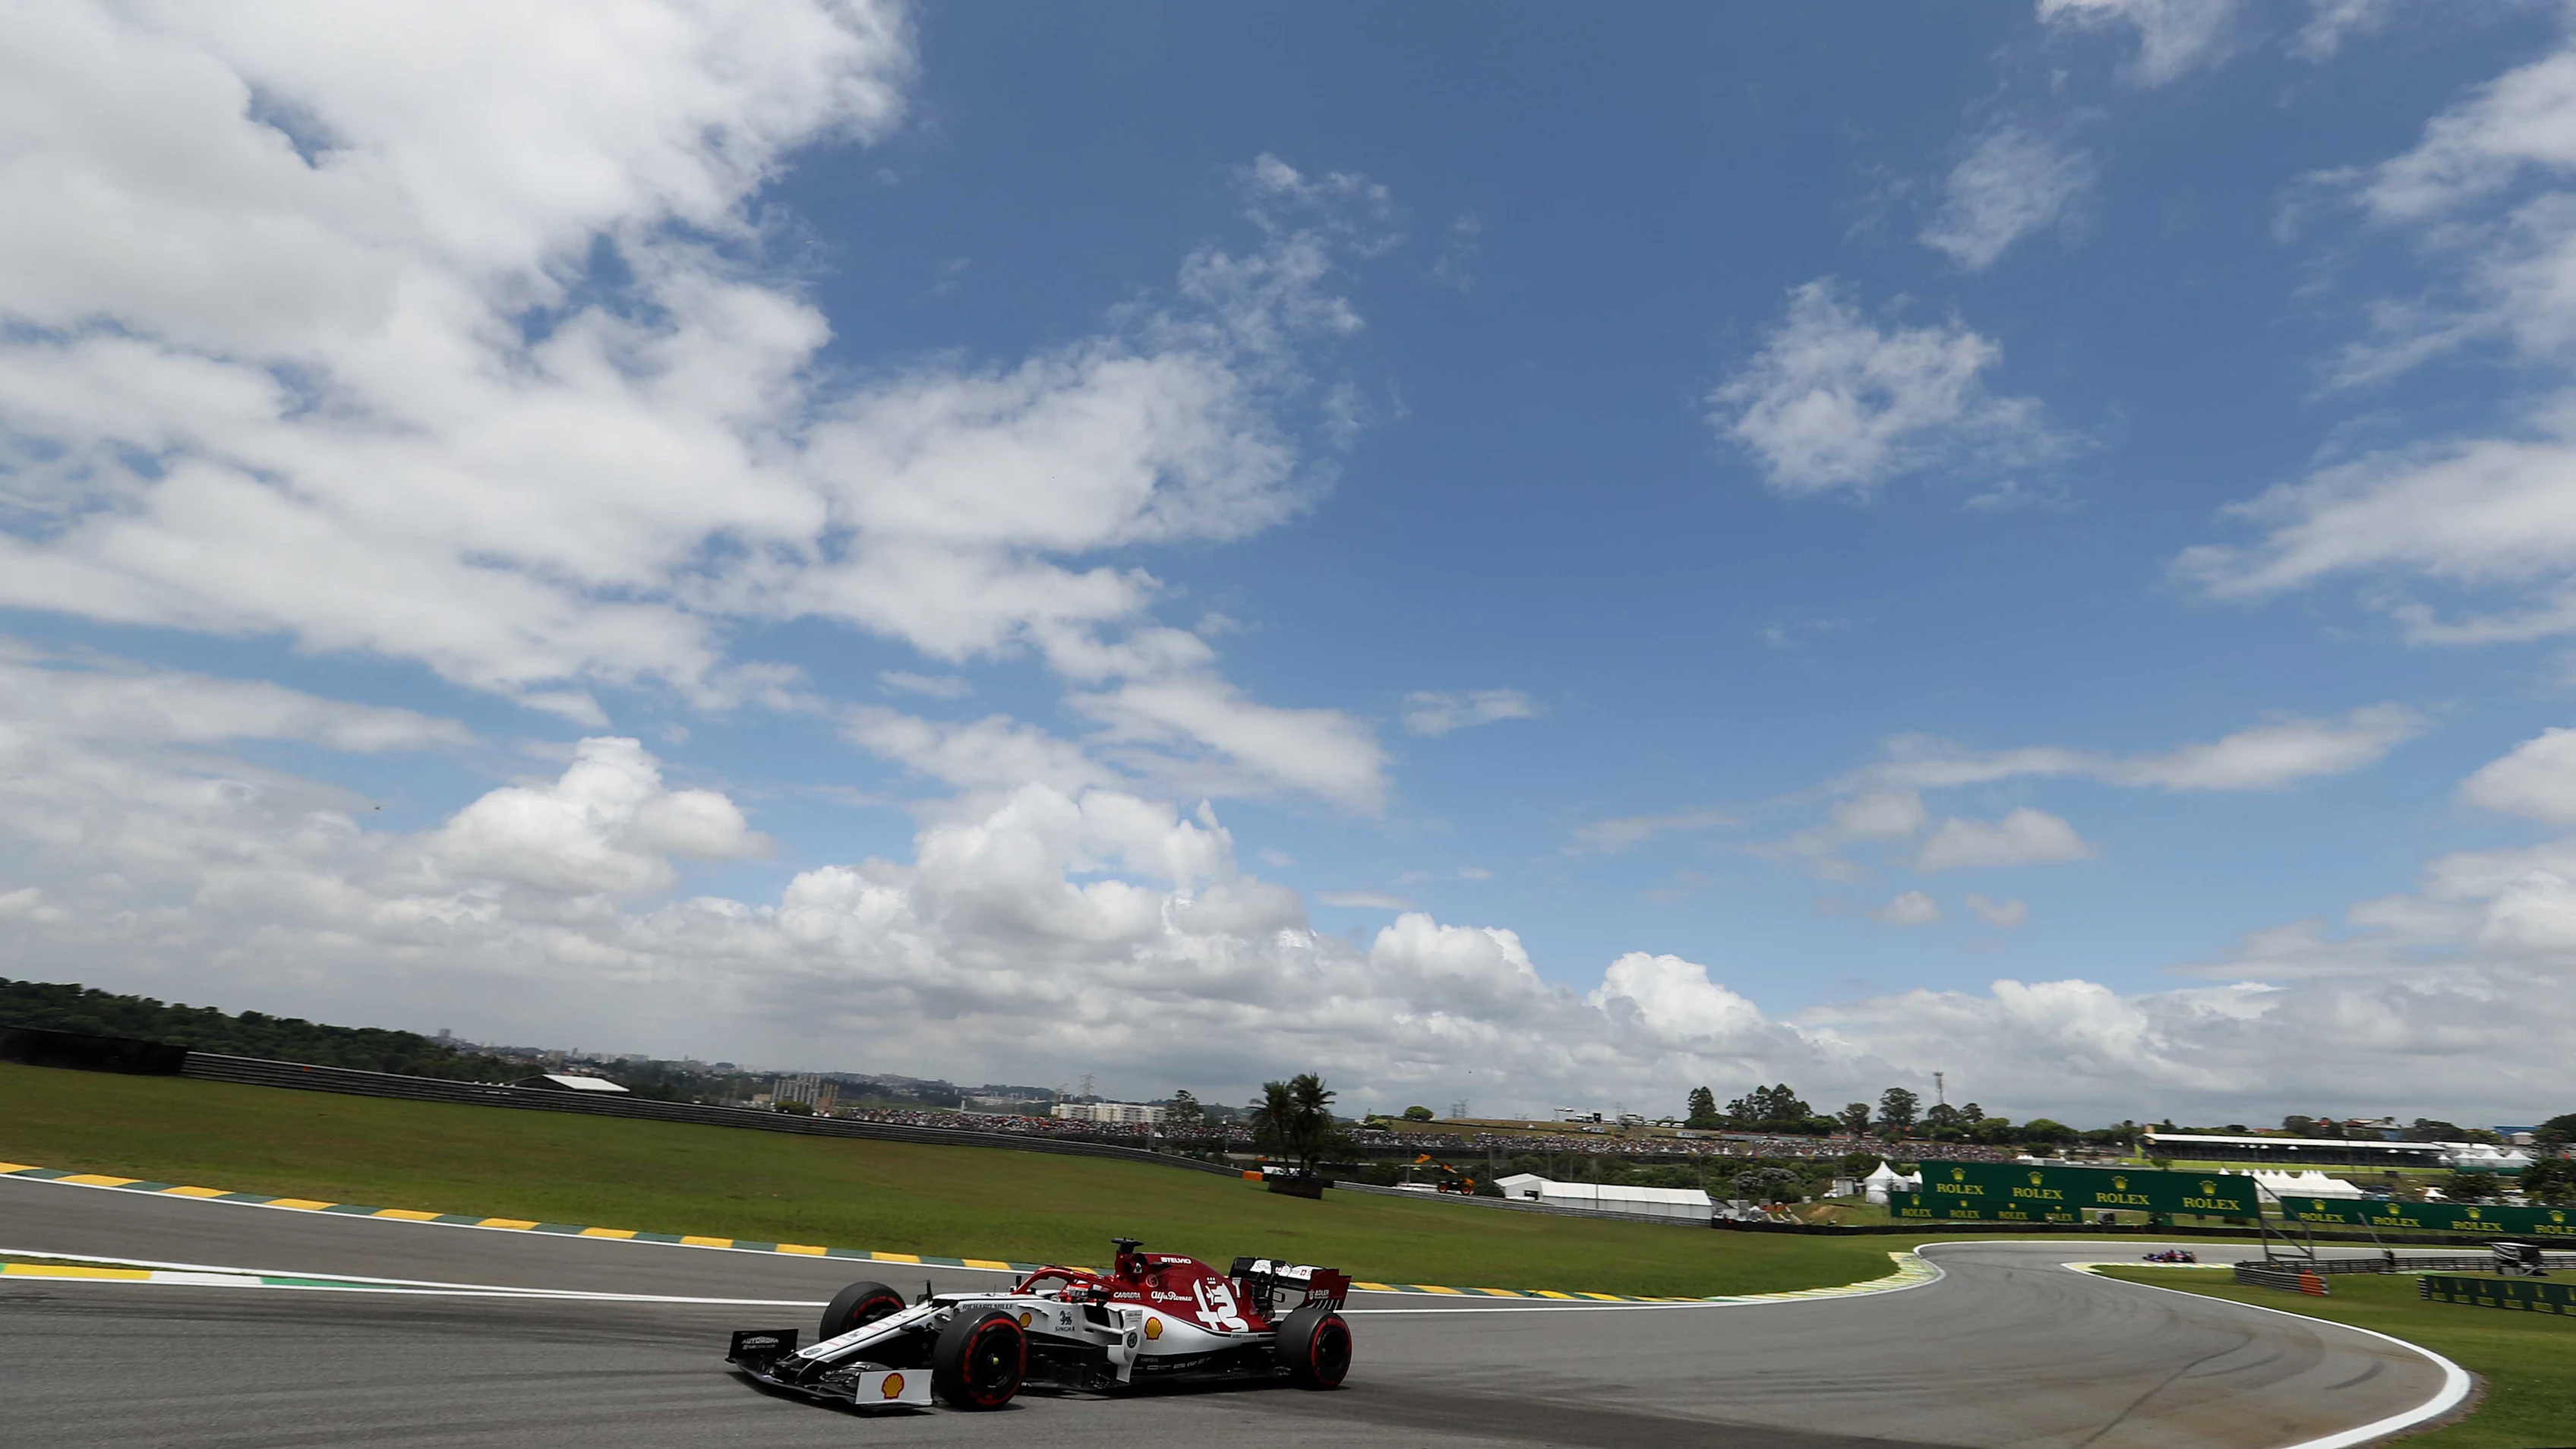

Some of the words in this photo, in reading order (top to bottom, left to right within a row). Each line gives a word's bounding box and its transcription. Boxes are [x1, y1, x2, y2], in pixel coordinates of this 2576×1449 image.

[1937, 1183, 1984, 1195] ROLEX
[2012, 1187, 2063, 1200] ROLEX
[2095, 1192, 2151, 1205] ROLEX
[2183, 1197, 2241, 1211] ROLEX
[1901, 1208, 1932, 1217] ROLEX
[1949, 1210, 1980, 1219] ROLEX
[1998, 1211, 2028, 1220] ROLEX
[2298, 1213, 2345, 1223] ROLEX
[2372, 1217, 2422, 1227] ROLEX
[2451, 1220, 2505, 1232] ROLEX
[2533, 1225, 2576, 1236] ROLE
[1151, 1291, 1169, 1303] Alfa
[1168, 1291, 1193, 1302] Romeo
